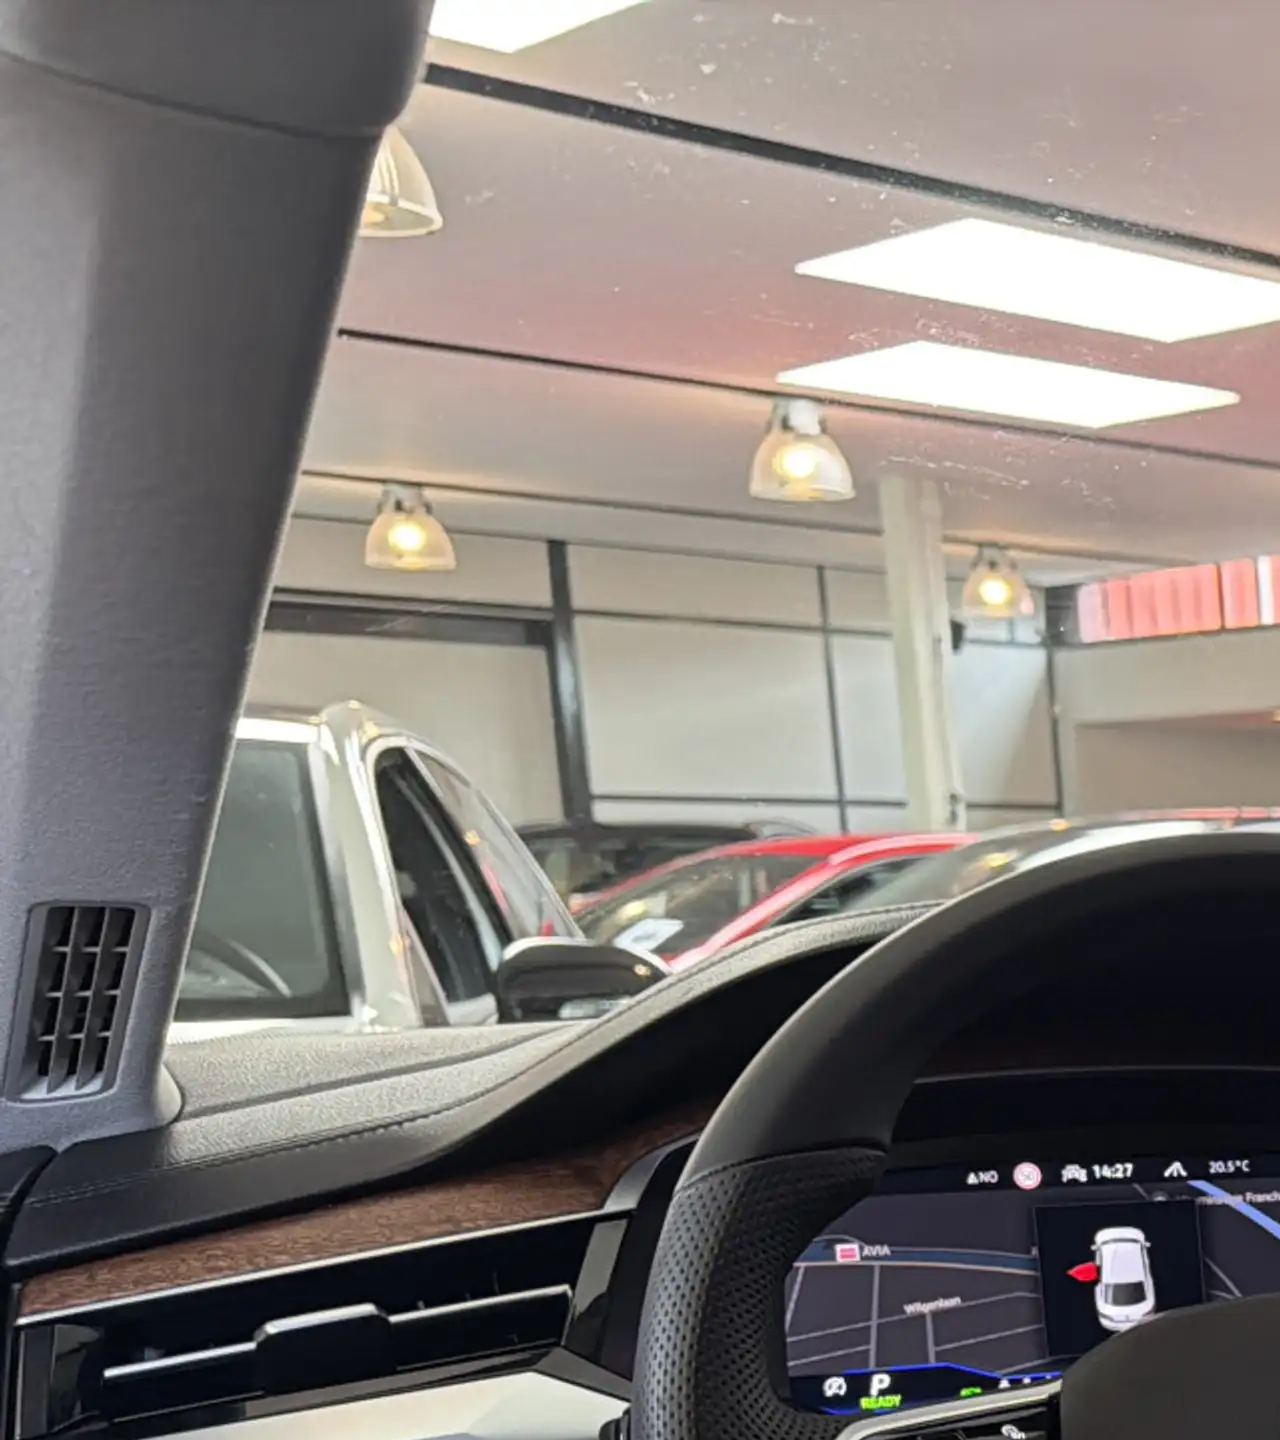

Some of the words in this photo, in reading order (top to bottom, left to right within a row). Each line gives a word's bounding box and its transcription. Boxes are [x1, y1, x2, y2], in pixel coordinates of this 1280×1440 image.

[1092, 1164, 1134, 1179] 14:27
[862, 1244, 891, 1257] AVIA
[869, 1373, 892, 1397] P
[860, 1395, 902, 1410] READY
